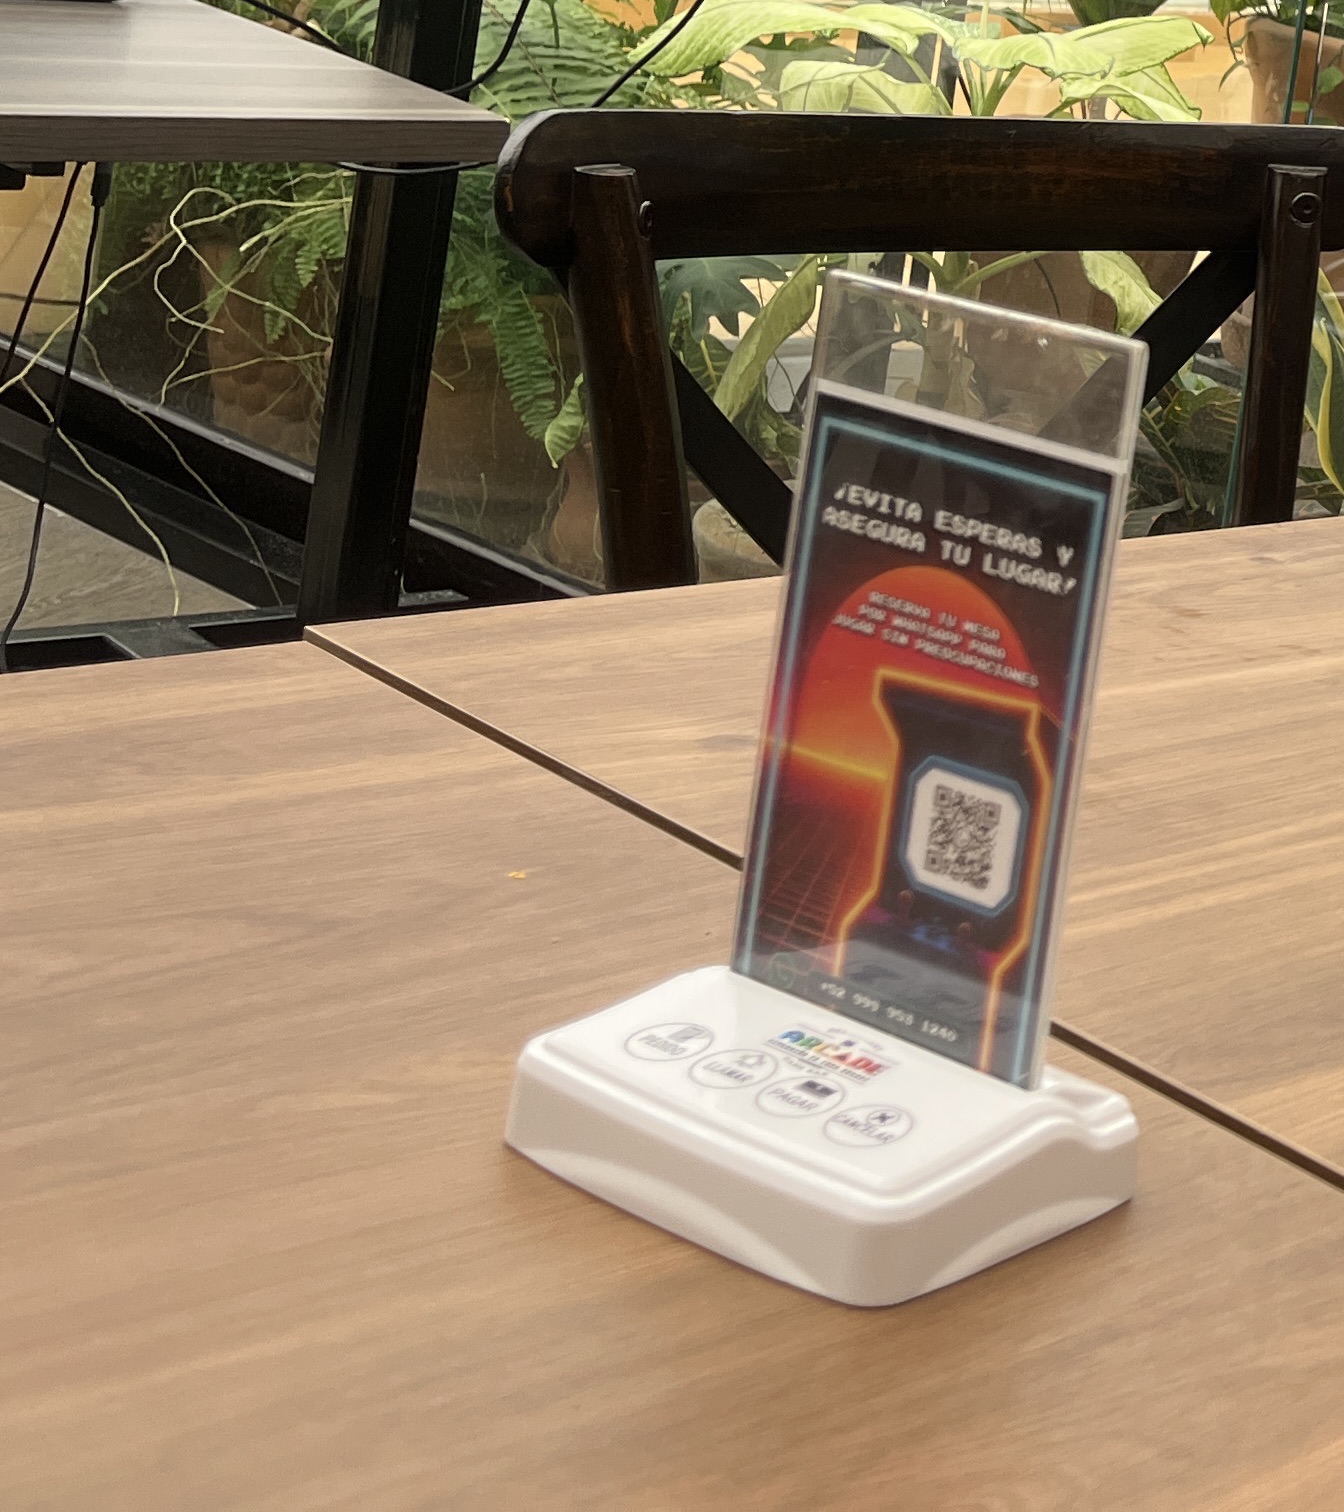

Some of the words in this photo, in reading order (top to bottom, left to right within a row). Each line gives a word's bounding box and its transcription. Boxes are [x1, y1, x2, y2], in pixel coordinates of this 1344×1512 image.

[821, 505, 926, 553] ASEGURA
[940, 539, 972, 566] TU
[982, 552, 1077, 596] LUGAR!
[933, 510, 1043, 559] ESPERAS
[1056, 544, 1075, 568] Y
[968, 639, 1006, 659] PARA
[702, 1060, 754, 1083] LLAMAR
[766, 1087, 820, 1112] PAGAR
[831, 1112, 897, 1143] CANCELAR
